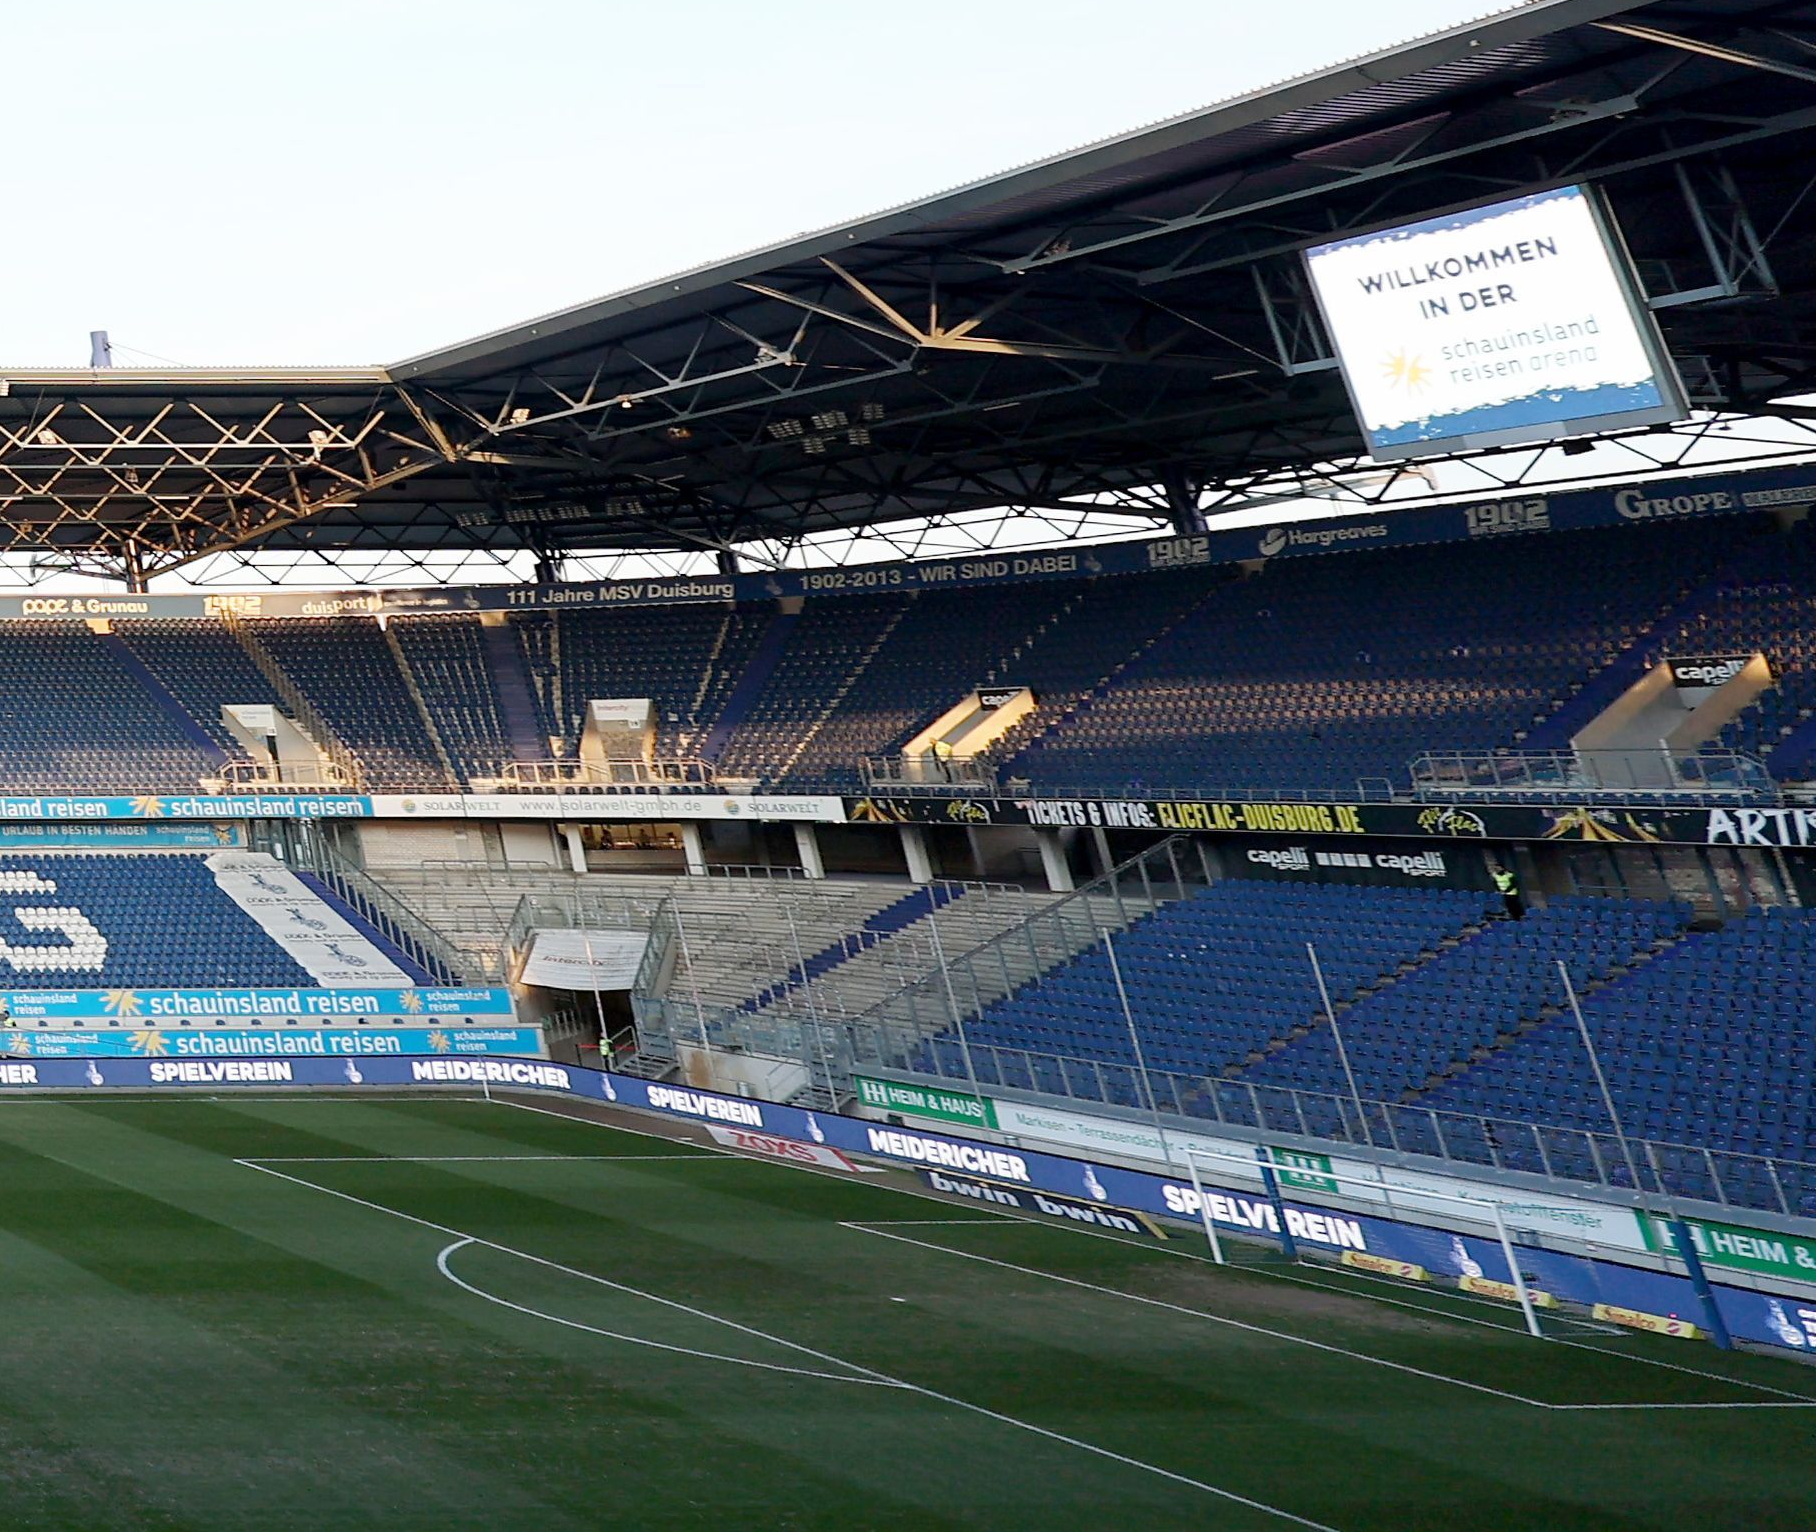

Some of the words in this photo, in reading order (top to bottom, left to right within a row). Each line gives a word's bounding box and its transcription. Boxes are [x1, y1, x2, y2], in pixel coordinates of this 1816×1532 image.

[1357, 236, 1560, 296] WILLKOMMEN
[1418, 295, 1451, 320] IN
[1458, 283, 1518, 313] DER
[1529, 345, 1598, 373] arena
[1288, 523, 1388, 548] Hargreaves
[799, 570, 902, 591] 1902-2013
[920, 565, 957, 583] WIR
[960, 560, 1010, 580] SIND
[1015, 555, 1077, 575] DABEI
[301, 596, 367, 615] duisport
[506, 589, 536, 606] 111
[541, 587, 595, 604] Jahre
[599, 585, 644, 601] MSV
[647, 581, 736, 602] Duisburg
[72, 600, 85, 614] &
[87, 600, 148, 615] Grunau
[47, 798, 107, 816] reisen
[172, 796, 295, 816] schauinsland
[299, 797, 362, 815] reisen
[422, 801, 501, 813] SOLARWELT
[519, 799, 703, 814] www.solarwelt-gmbh.de
[747, 802, 820, 814] SOLARWELT
[1023, 801, 1086, 826] TICKETS
[1090, 803, 1100, 826] &
[2, 825, 43, 837] URLAUB
[61, 824, 101, 836] BESTEN
[104, 823, 148, 836] HÄNDEN
[1247, 847, 1310, 870] capelli
[1376, 851, 1444, 874] capelli
[150, 992, 303, 1014] schauinsland
[307, 992, 379, 1013] reisen
[176, 1032, 324, 1055] schauinsland
[329, 1033, 400, 1053] reisen
[150, 1061, 293, 1084] SPIELVEREIN
[411, 1060, 571, 1090] MEIDERICHER
[647, 1084, 763, 1128] SPIELVEREIN
[888, 1088, 923, 1109] HEIM
[926, 1093, 938, 1109] &
[940, 1096, 984, 1118] HAUS
[867, 1127, 1031, 1183] MEIDERICHER
[930, 1170, 1021, 1209] bwin
[1033, 1193, 1141, 1234] bwin
[1711, 1230, 1789, 1265] HEIM
